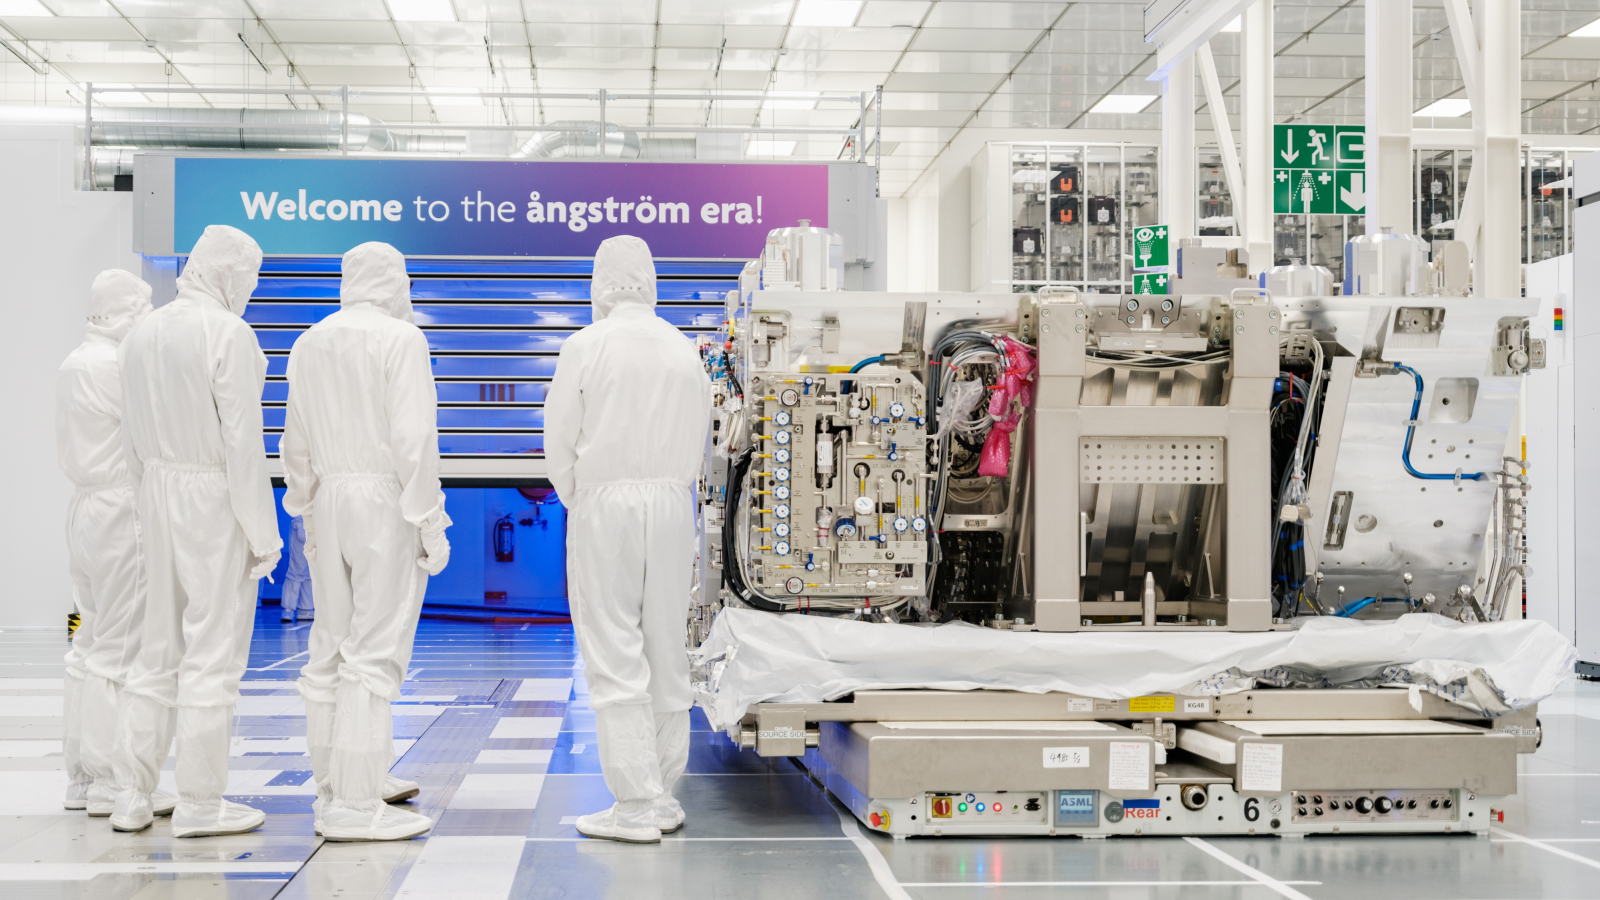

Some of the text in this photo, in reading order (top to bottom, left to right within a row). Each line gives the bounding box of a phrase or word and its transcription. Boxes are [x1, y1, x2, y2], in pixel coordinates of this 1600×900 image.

[240, 189, 763, 232] Welcome to the ångström era!
[758, 730, 806, 738] SOURCE SIDE
[1061, 797, 1093, 807] ASML
[1125, 807, 1161, 819] Rear
[1243, 797, 1260, 822] 6
